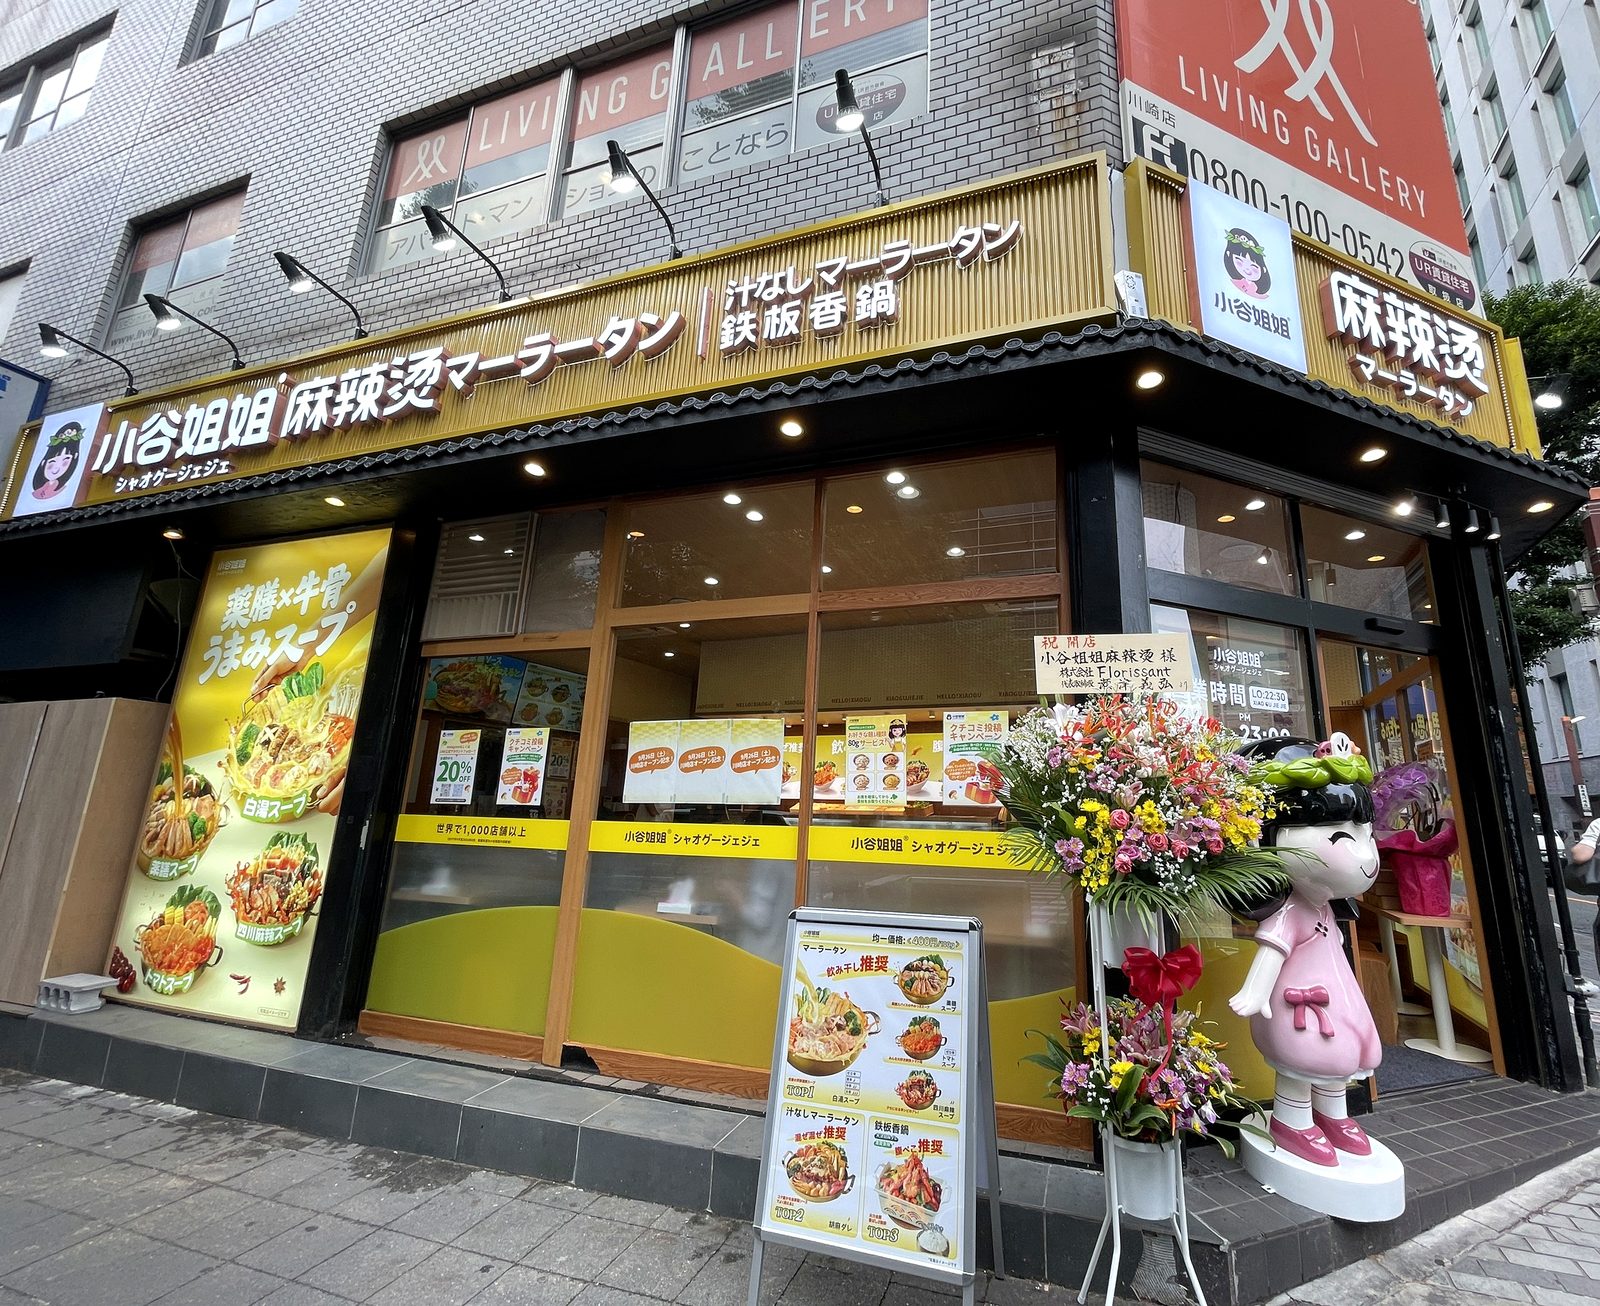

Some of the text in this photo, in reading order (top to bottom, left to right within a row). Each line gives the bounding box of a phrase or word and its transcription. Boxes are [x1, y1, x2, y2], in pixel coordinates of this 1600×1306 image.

[1128, 90, 1176, 129] 川崎店
[1178, 55, 1426, 219] LIVING GALLERY
[1190, 148, 1409, 284] 0800-100-0542
[725, 220, 1021, 311] 汁なしマーラータン
[719, 279, 896, 351] 鉄板香鍋
[1329, 271, 1488, 395] 麻辣烫
[1355, 353, 1474, 419] マーラータン
[115, 459, 230, 493] シャオグージェジェ
[220, 562, 352, 632] 薬膳×牛骨
[198, 601, 357, 685] うまみスープ
[1096, 665, 1172, 679] Florissant
[1251, 688, 1286, 702] LO:22:30
[1239, 712, 1252, 721] PM
[950, 723, 1003, 733] クチコミ投稿
[458, 775, 472, 783] OFF
[243, 794, 307, 820] 白湯スープ
[436, 823, 527, 837] 世界で1,000店舗以上
[673, 833, 760, 847] シャオグージェジェ
[802, 944, 847, 955] マーラータン
[826, 955, 889, 978] 飲み干し推奨
[787, 1084, 815, 1098] TOP1
[786, 1106, 859, 1126] 汁なしマーラータン
[874, 1120, 909, 1135] 鉄板香鍋
[775, 1206, 805, 1223] TOP2
[867, 1225, 900, 1243] TOP3
